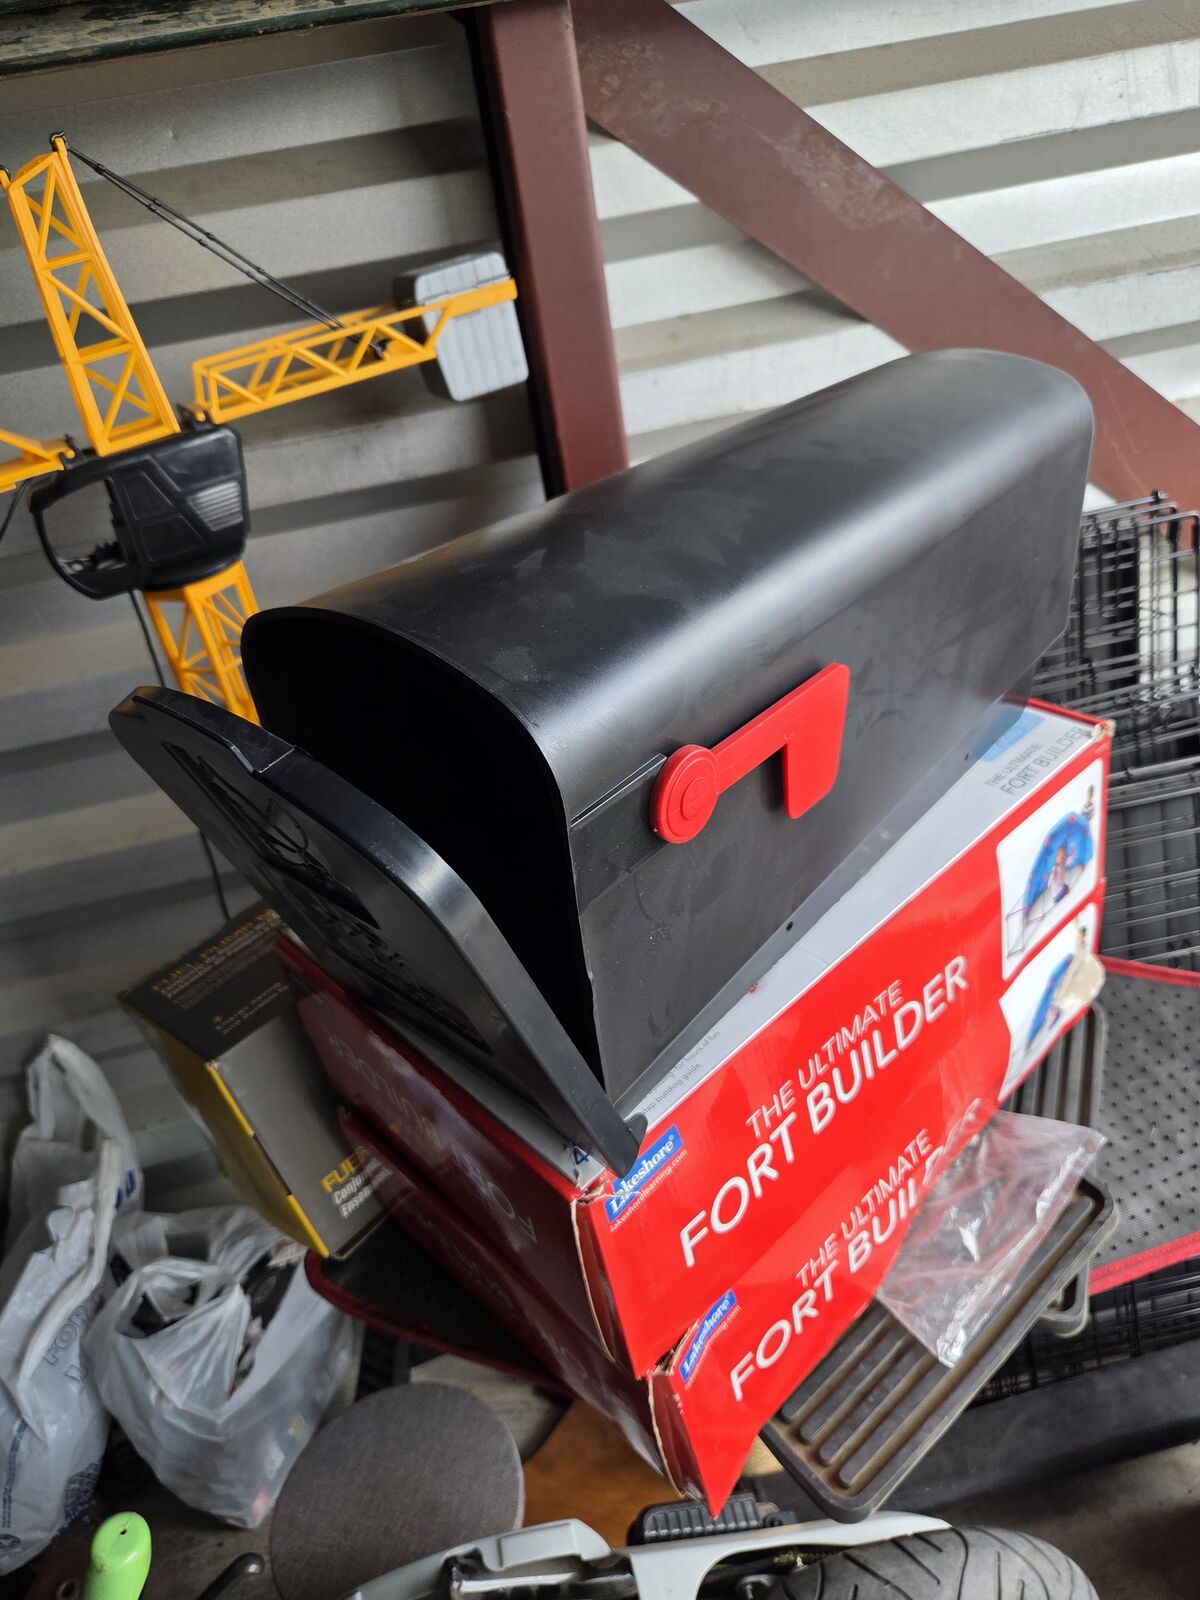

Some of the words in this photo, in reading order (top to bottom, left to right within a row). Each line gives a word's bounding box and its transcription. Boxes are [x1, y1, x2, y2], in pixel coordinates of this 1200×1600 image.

[984, 770, 1006, 787] THE
[1005, 742, 1042, 773] ULTIMATE
[1000, 764, 1040, 796] FORT
[1032, 726, 1093, 769] BUILDER
[655, 1079, 684, 1103] building
[682, 1063, 702, 1081] guide
[745, 1079, 797, 1139] THE
[798, 979, 905, 1090] ULTIMATE
[680, 1112, 797, 1268] FORT
[806, 955, 969, 1136] BUILDER
[320, 1153, 361, 1194] FUE
[333, 1173, 366, 1206] Conju
[796, 1232, 839, 1288] THE
[841, 1128, 933, 1239] ULTIMATE
[730, 1259, 840, 1402] FORT
